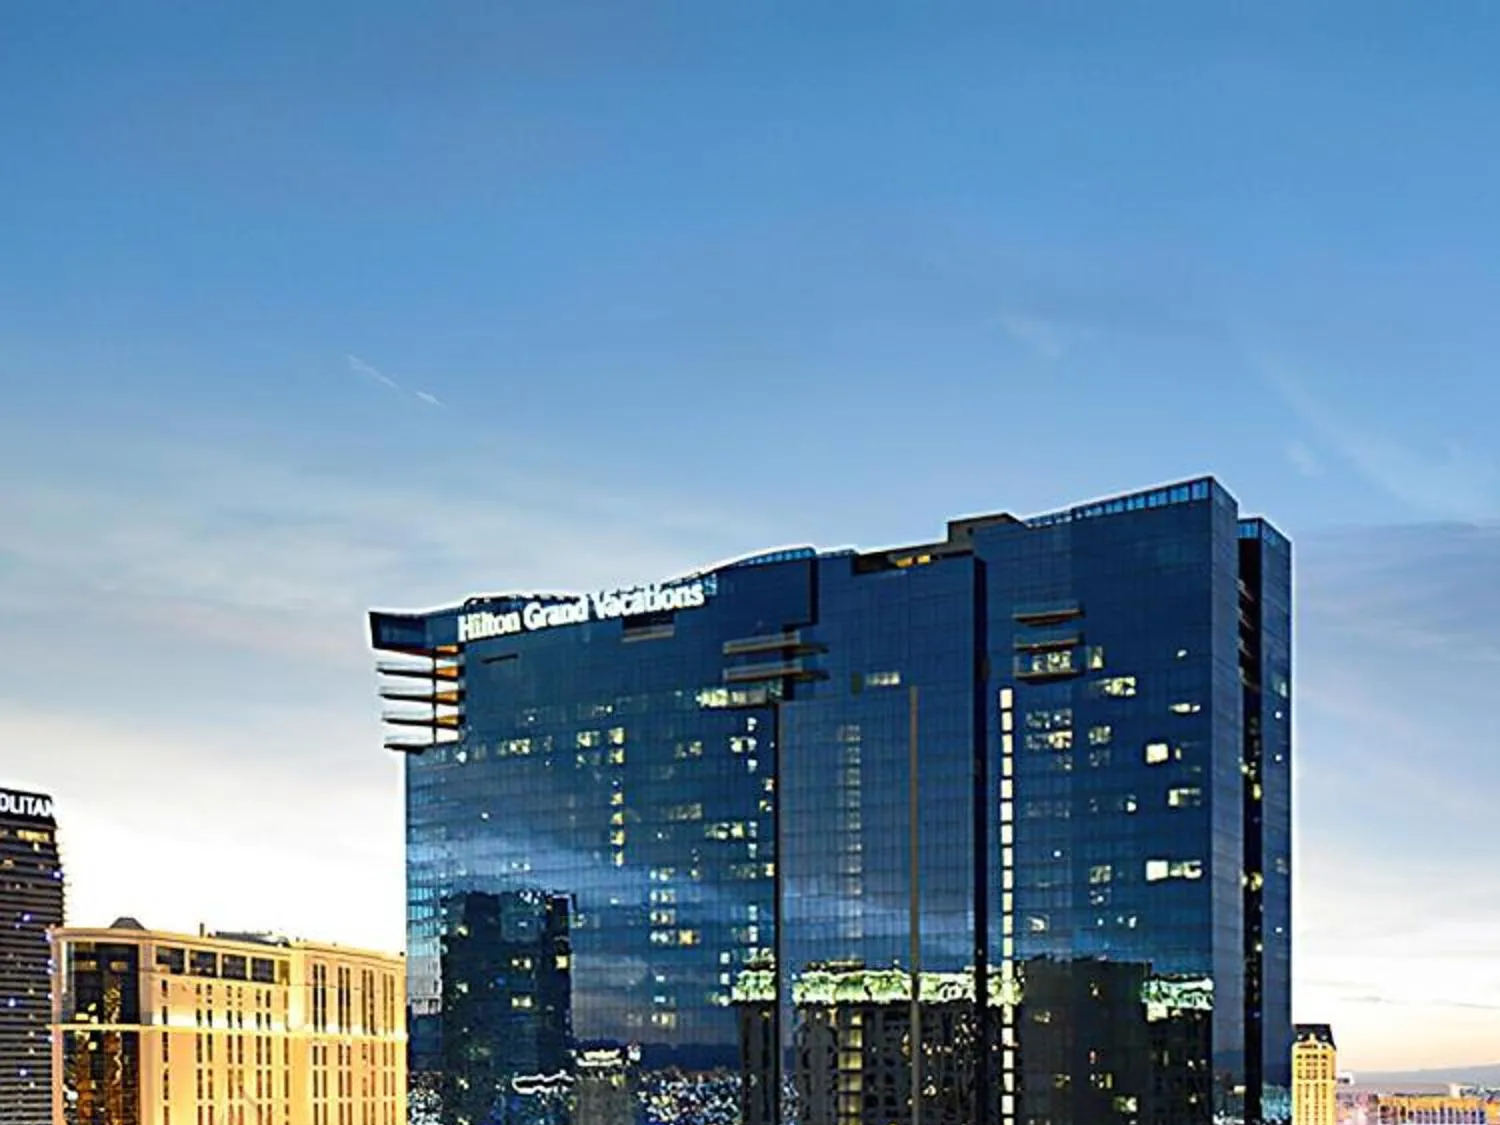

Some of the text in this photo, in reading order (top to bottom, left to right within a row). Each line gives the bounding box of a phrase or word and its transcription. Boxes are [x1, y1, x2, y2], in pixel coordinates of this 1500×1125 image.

[457, 581, 705, 642] Hilton Grand Vacations
